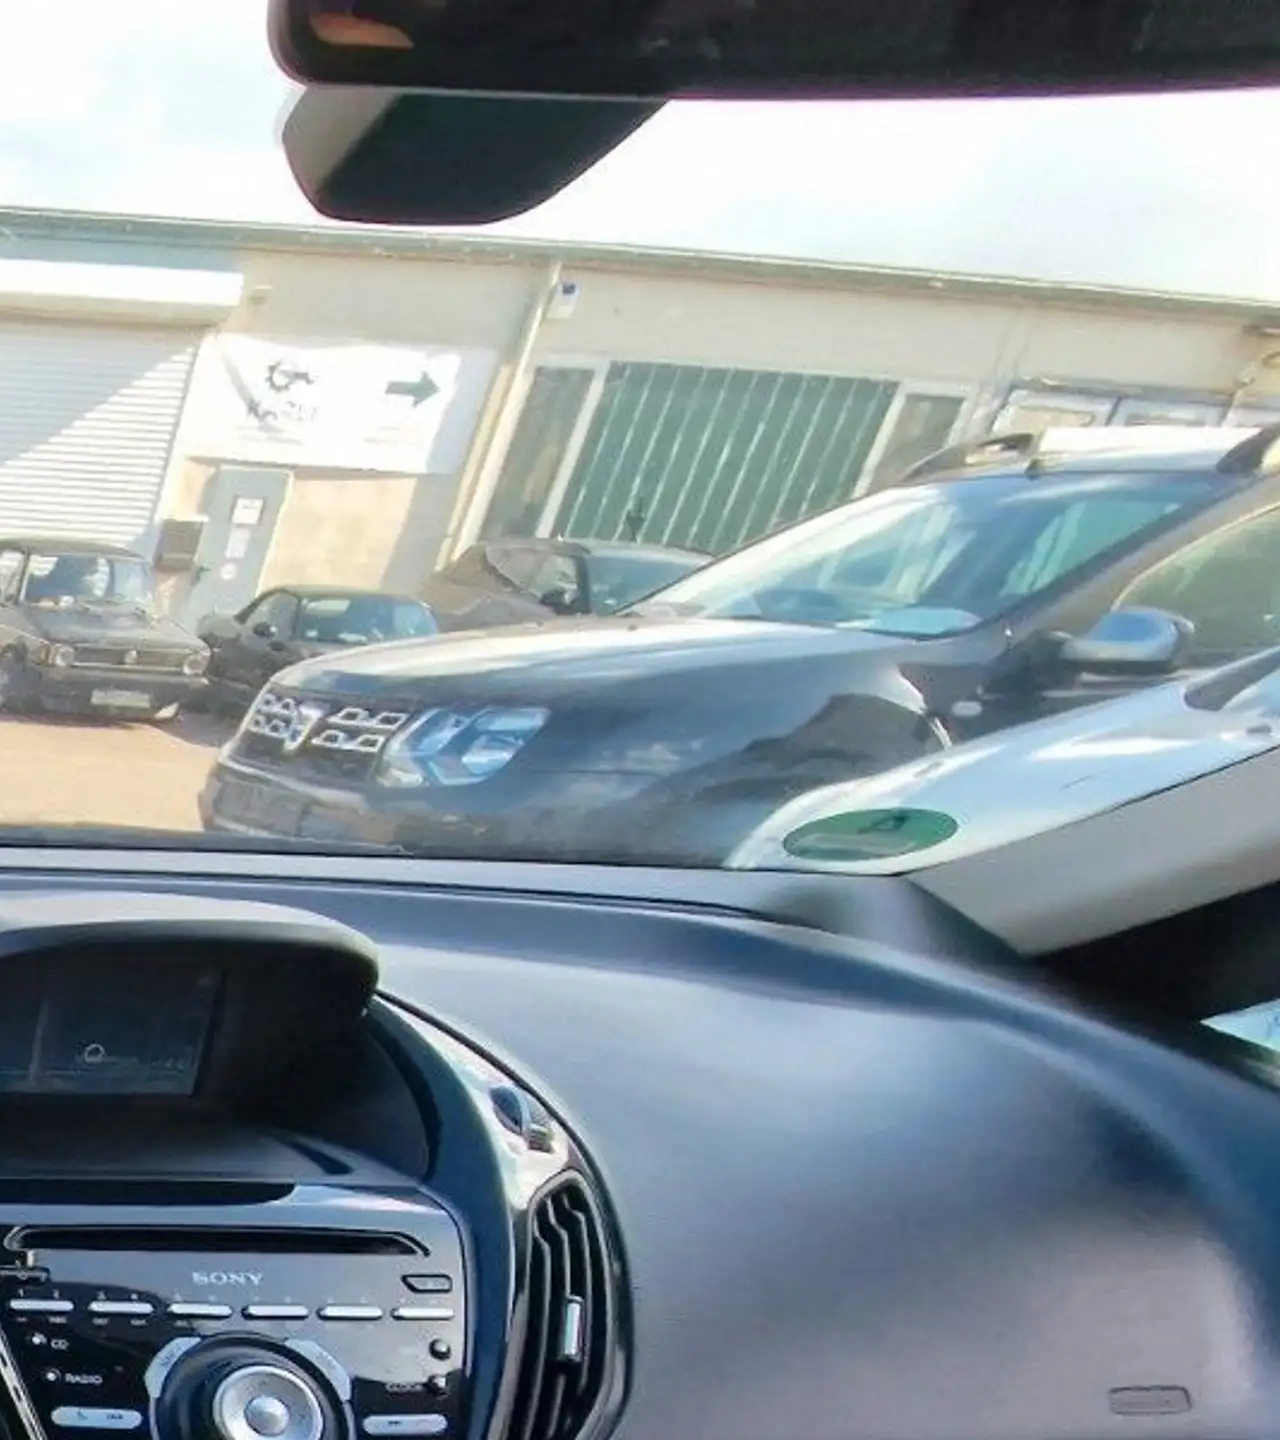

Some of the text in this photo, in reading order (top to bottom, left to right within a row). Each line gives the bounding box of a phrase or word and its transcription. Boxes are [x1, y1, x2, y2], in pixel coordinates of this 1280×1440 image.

[192, 1271, 263, 1286] SONY
[50, 1339, 69, 1350] CD
[65, 1375, 103, 1385] RADIO
